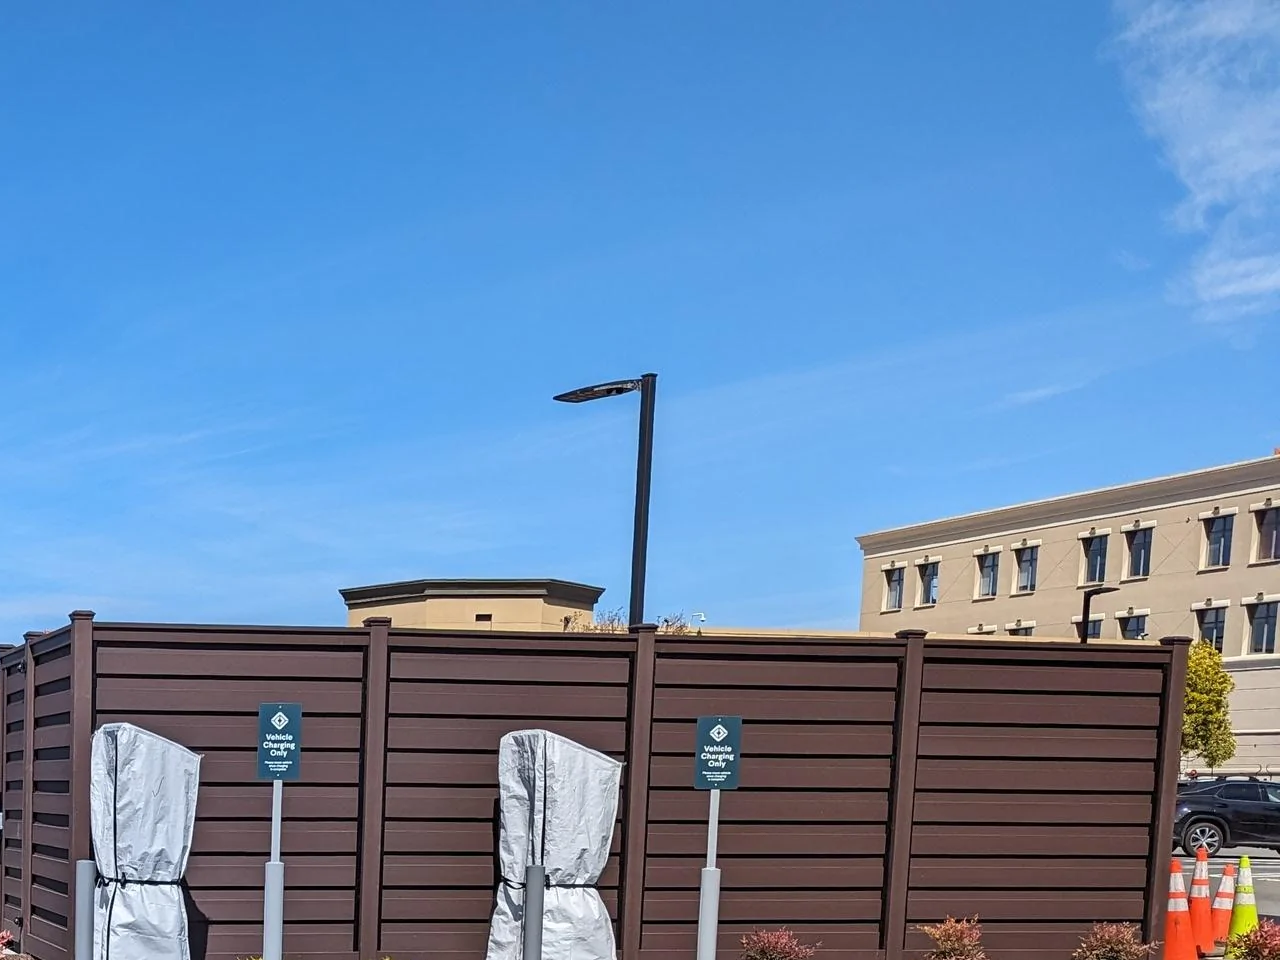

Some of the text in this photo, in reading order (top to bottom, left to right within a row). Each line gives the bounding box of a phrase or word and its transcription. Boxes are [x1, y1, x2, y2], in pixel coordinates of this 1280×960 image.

[265, 733, 293, 741] Vehicle
[263, 741, 296, 750] Charging
[270, 749, 288, 758] Only
[700, 753, 735, 761] Charging
[708, 760, 727, 768] Only
